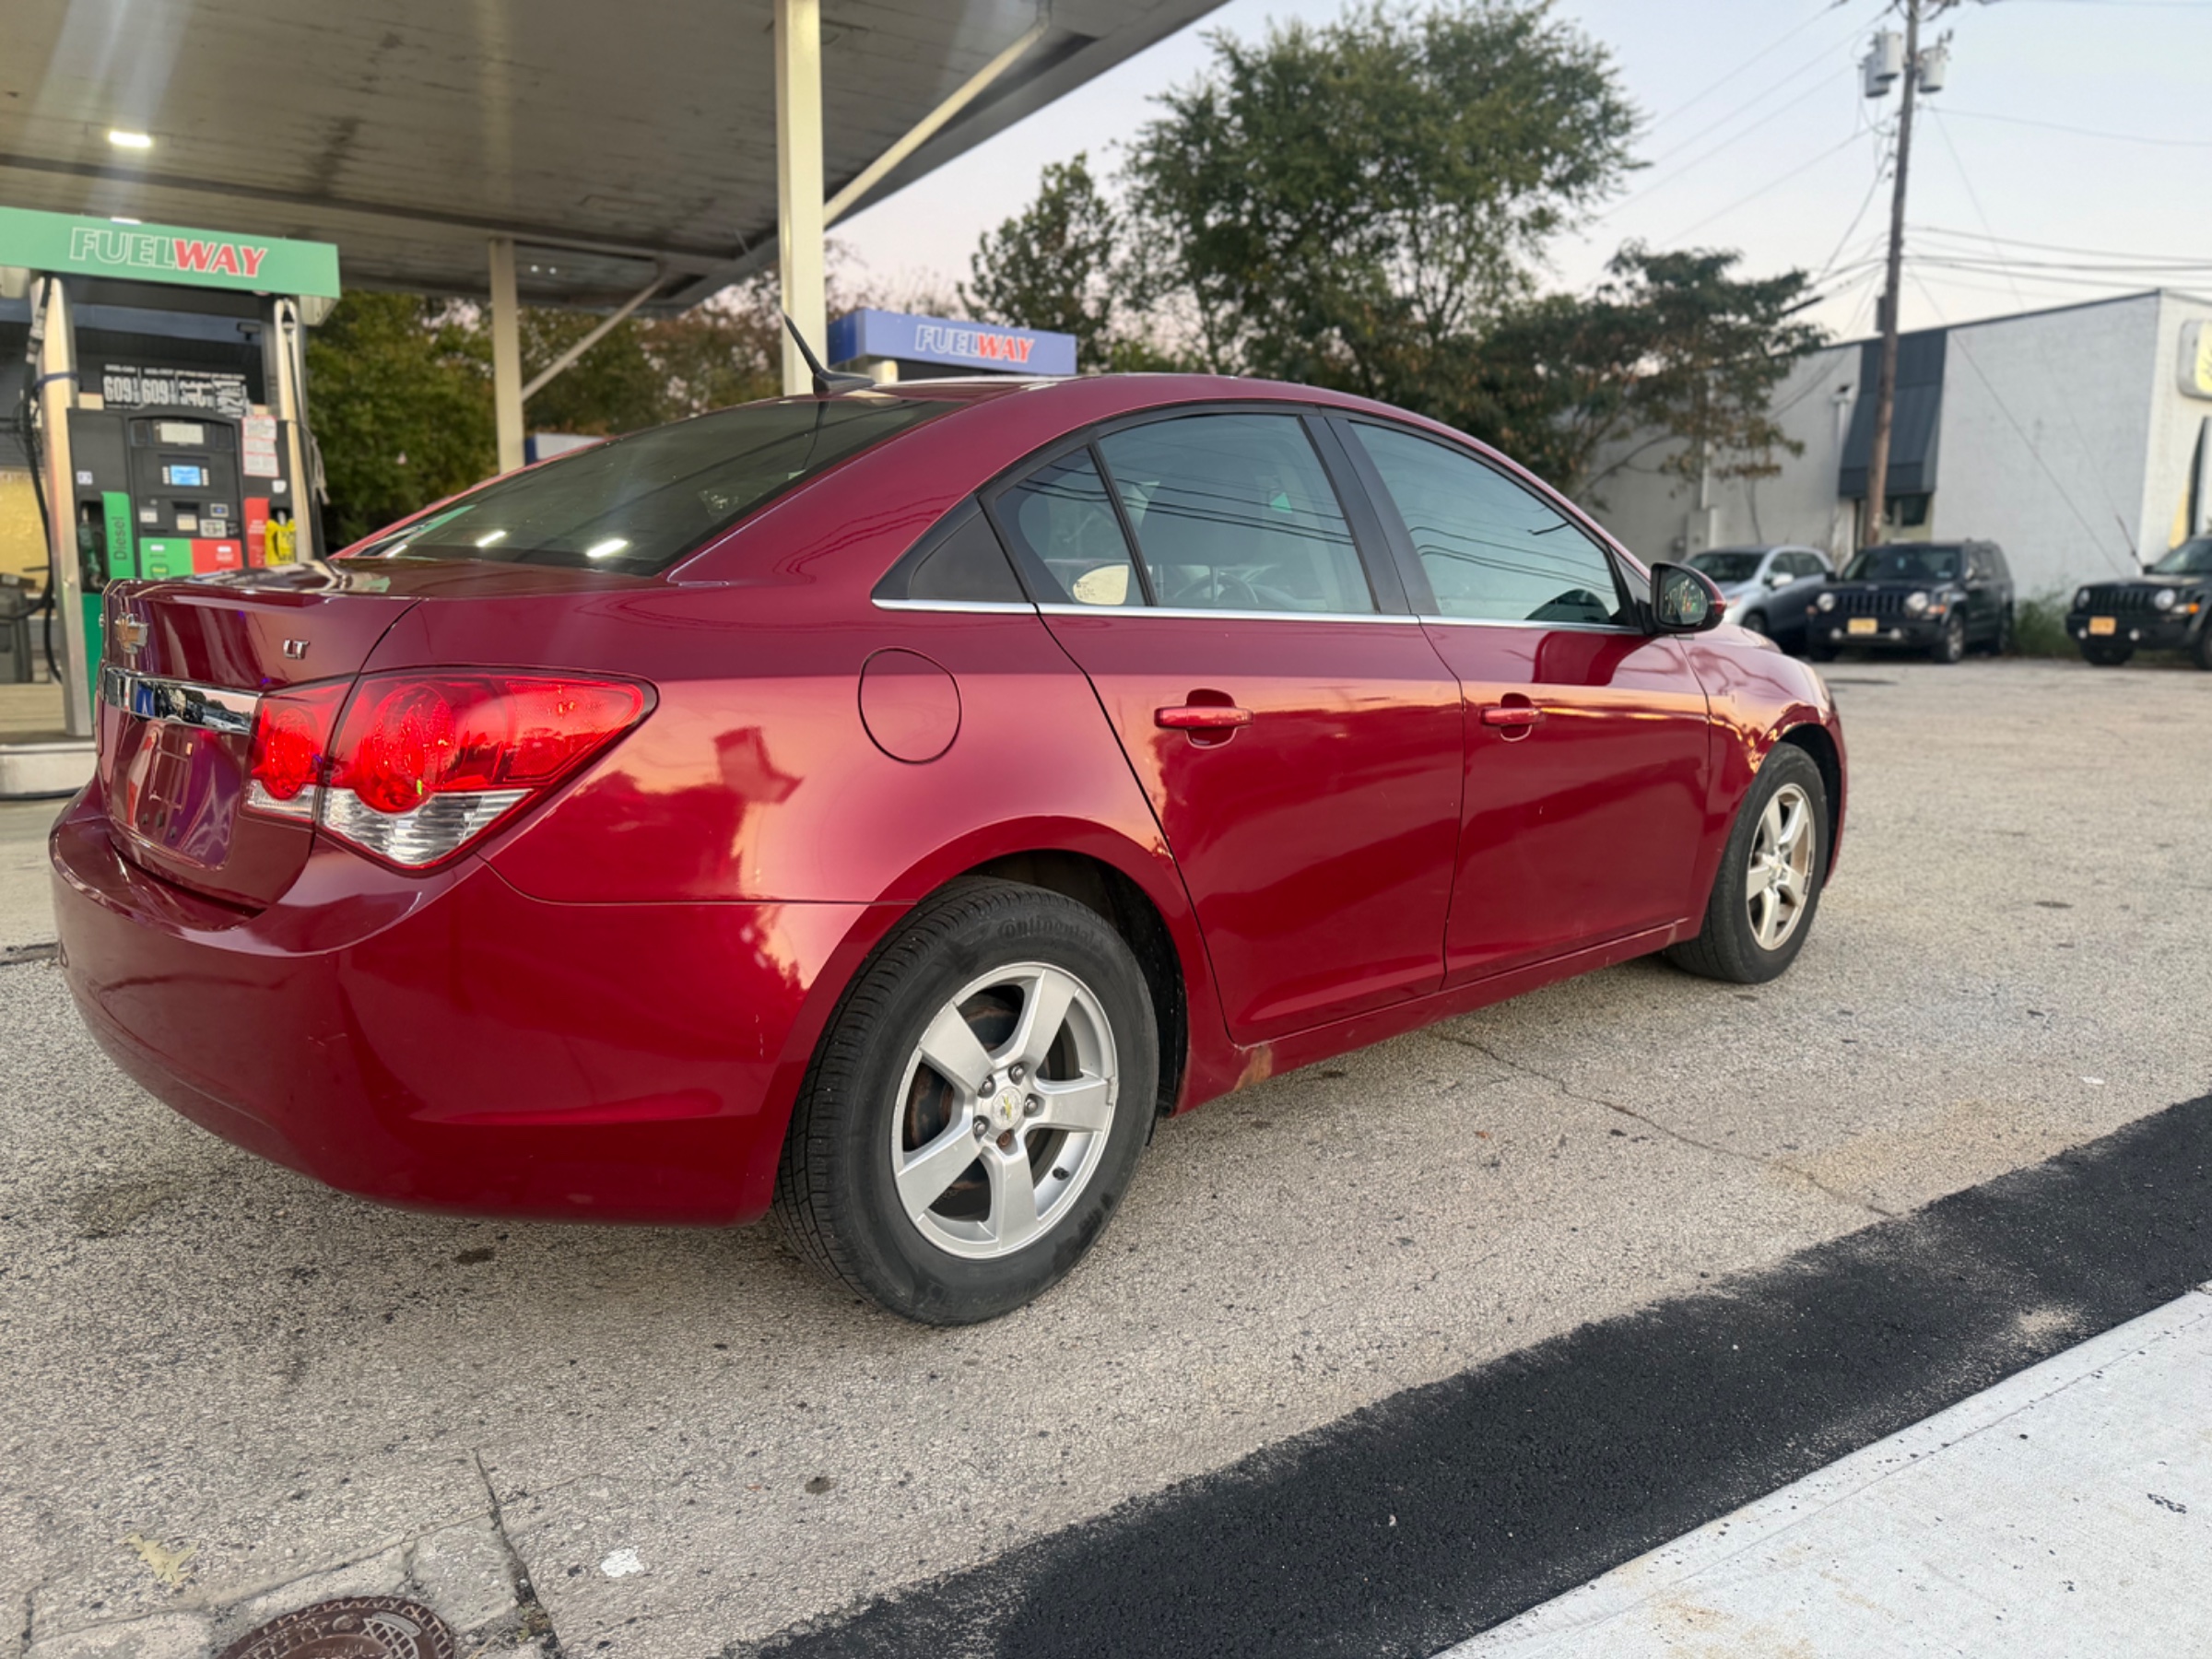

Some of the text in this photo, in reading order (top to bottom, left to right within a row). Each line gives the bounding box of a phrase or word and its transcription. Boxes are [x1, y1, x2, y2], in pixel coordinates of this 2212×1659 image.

[69, 227, 268, 277] FUELWAY
[914, 324, 1035, 363] FUELWAY
[111, 516, 127, 560] Diesel
[283, 639, 310, 660] LT
